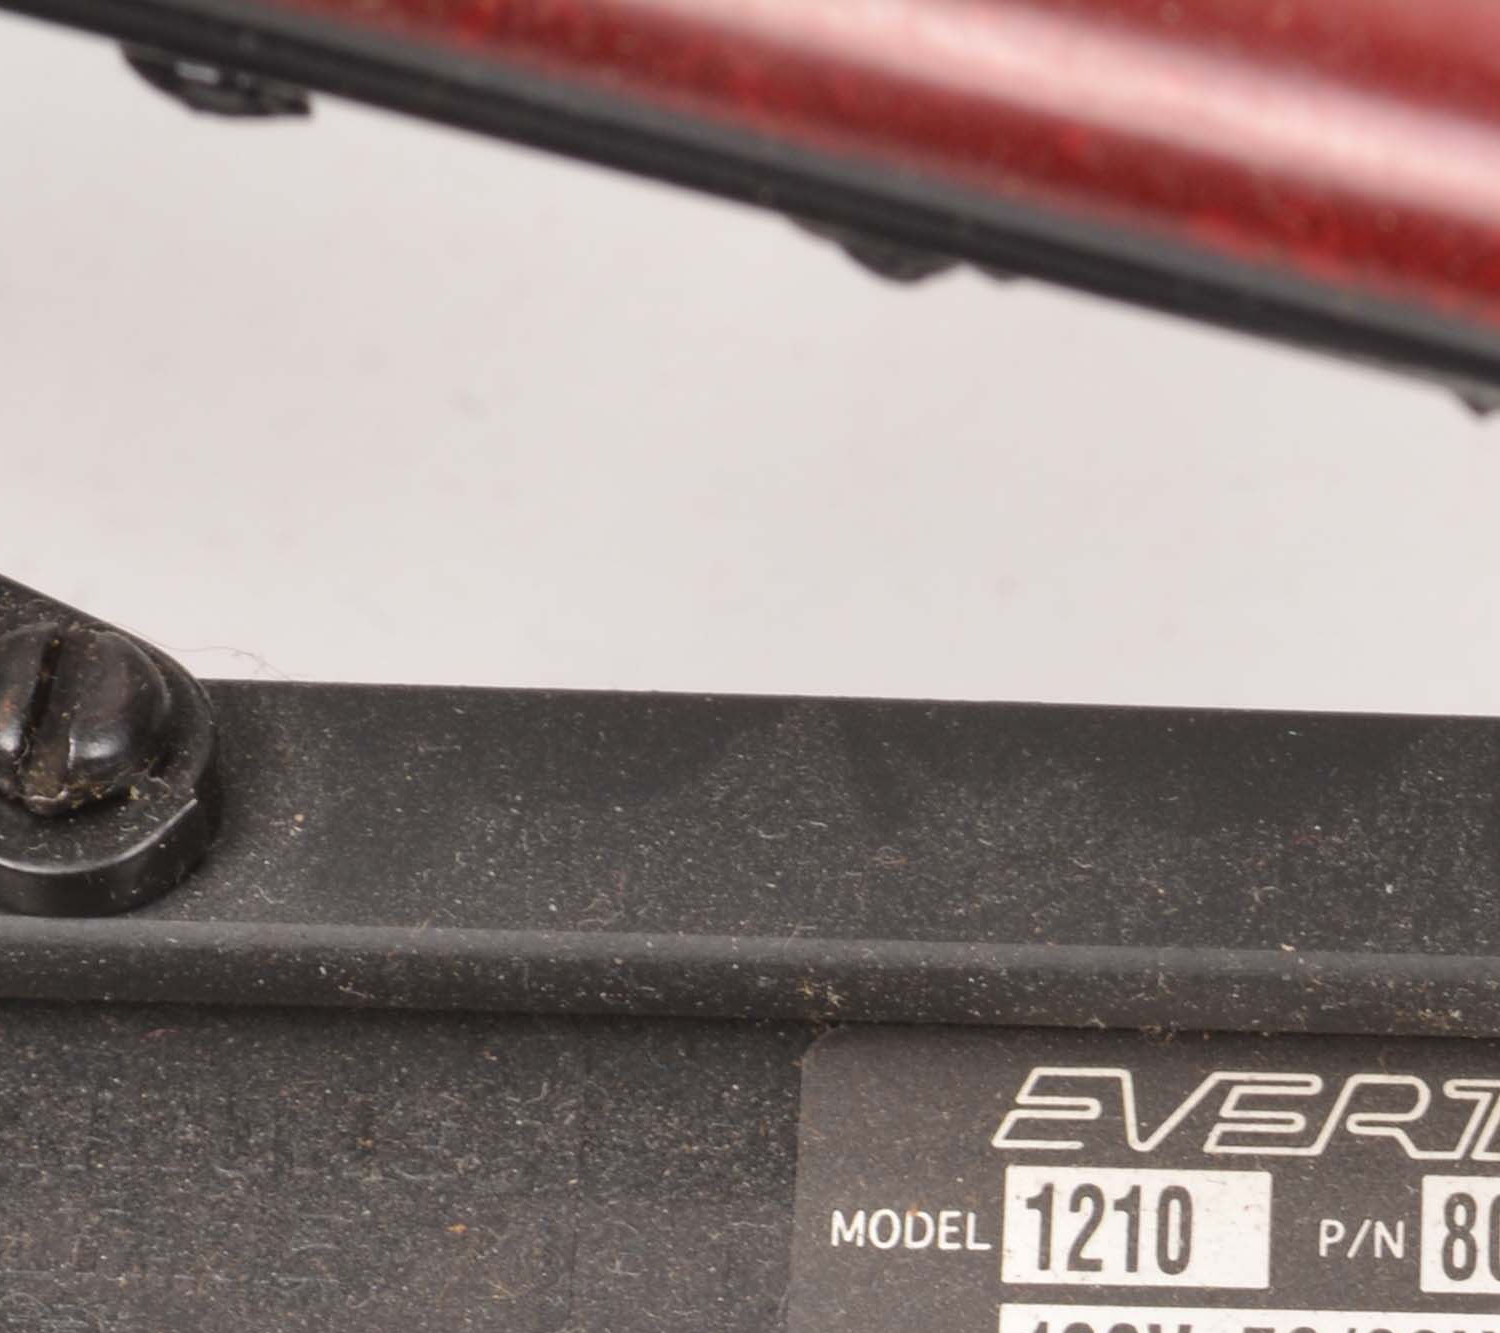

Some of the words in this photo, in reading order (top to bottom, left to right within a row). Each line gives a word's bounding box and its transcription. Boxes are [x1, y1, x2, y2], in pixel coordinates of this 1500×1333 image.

[829, 1208, 993, 1251] MODEL
[1025, 1181, 1194, 1276] 1210
[1318, 1218, 1406, 1259] P/N
